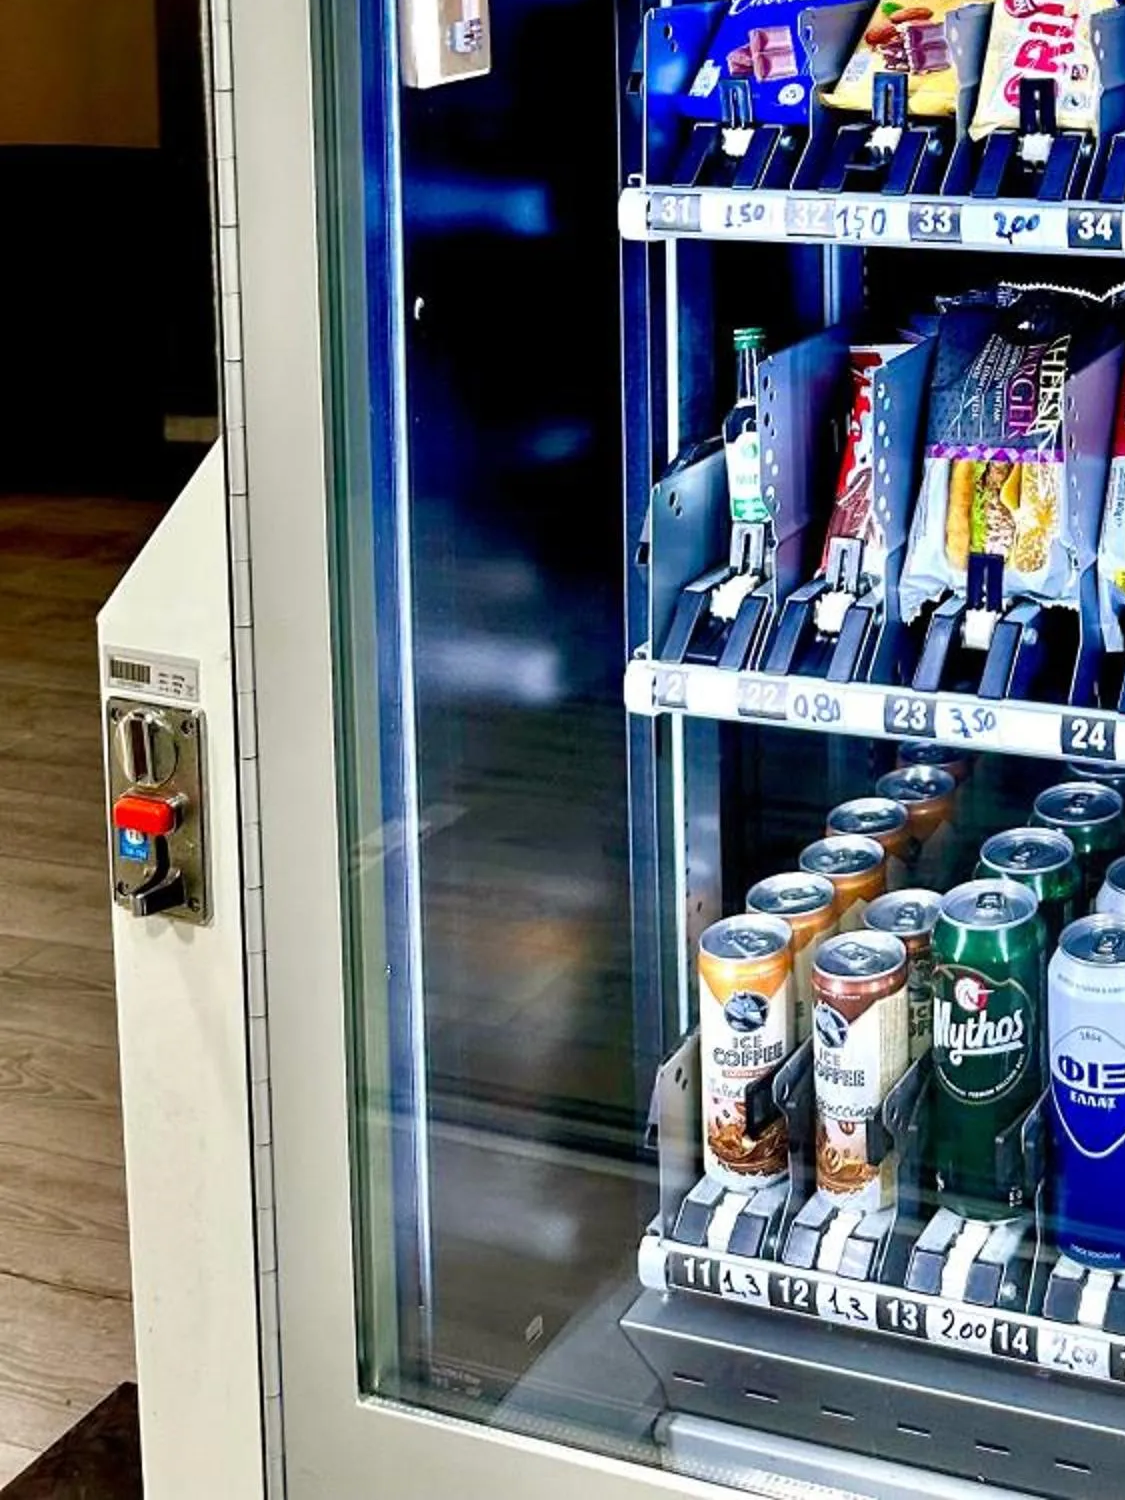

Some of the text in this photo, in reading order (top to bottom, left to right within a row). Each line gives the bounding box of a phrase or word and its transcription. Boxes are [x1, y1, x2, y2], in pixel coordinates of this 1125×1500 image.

[660, 196, 692, 222] 31
[916, 204, 952, 233] 33
[1076, 211, 1113, 240] 34
[748, 682, 783, 711] 22
[892, 699, 928, 730] 23
[1070, 718, 1108, 750] 24
[713, 1040, 785, 1067] COFFEE
[731, 1035, 763, 1049] ICE
[933, 998, 1025, 1066] Mythos
[683, 1257, 712, 1286] 11
[779, 1276, 809, 1307] 12
[886, 1300, 920, 1331] 13
[997, 1323, 1030, 1356] 14
